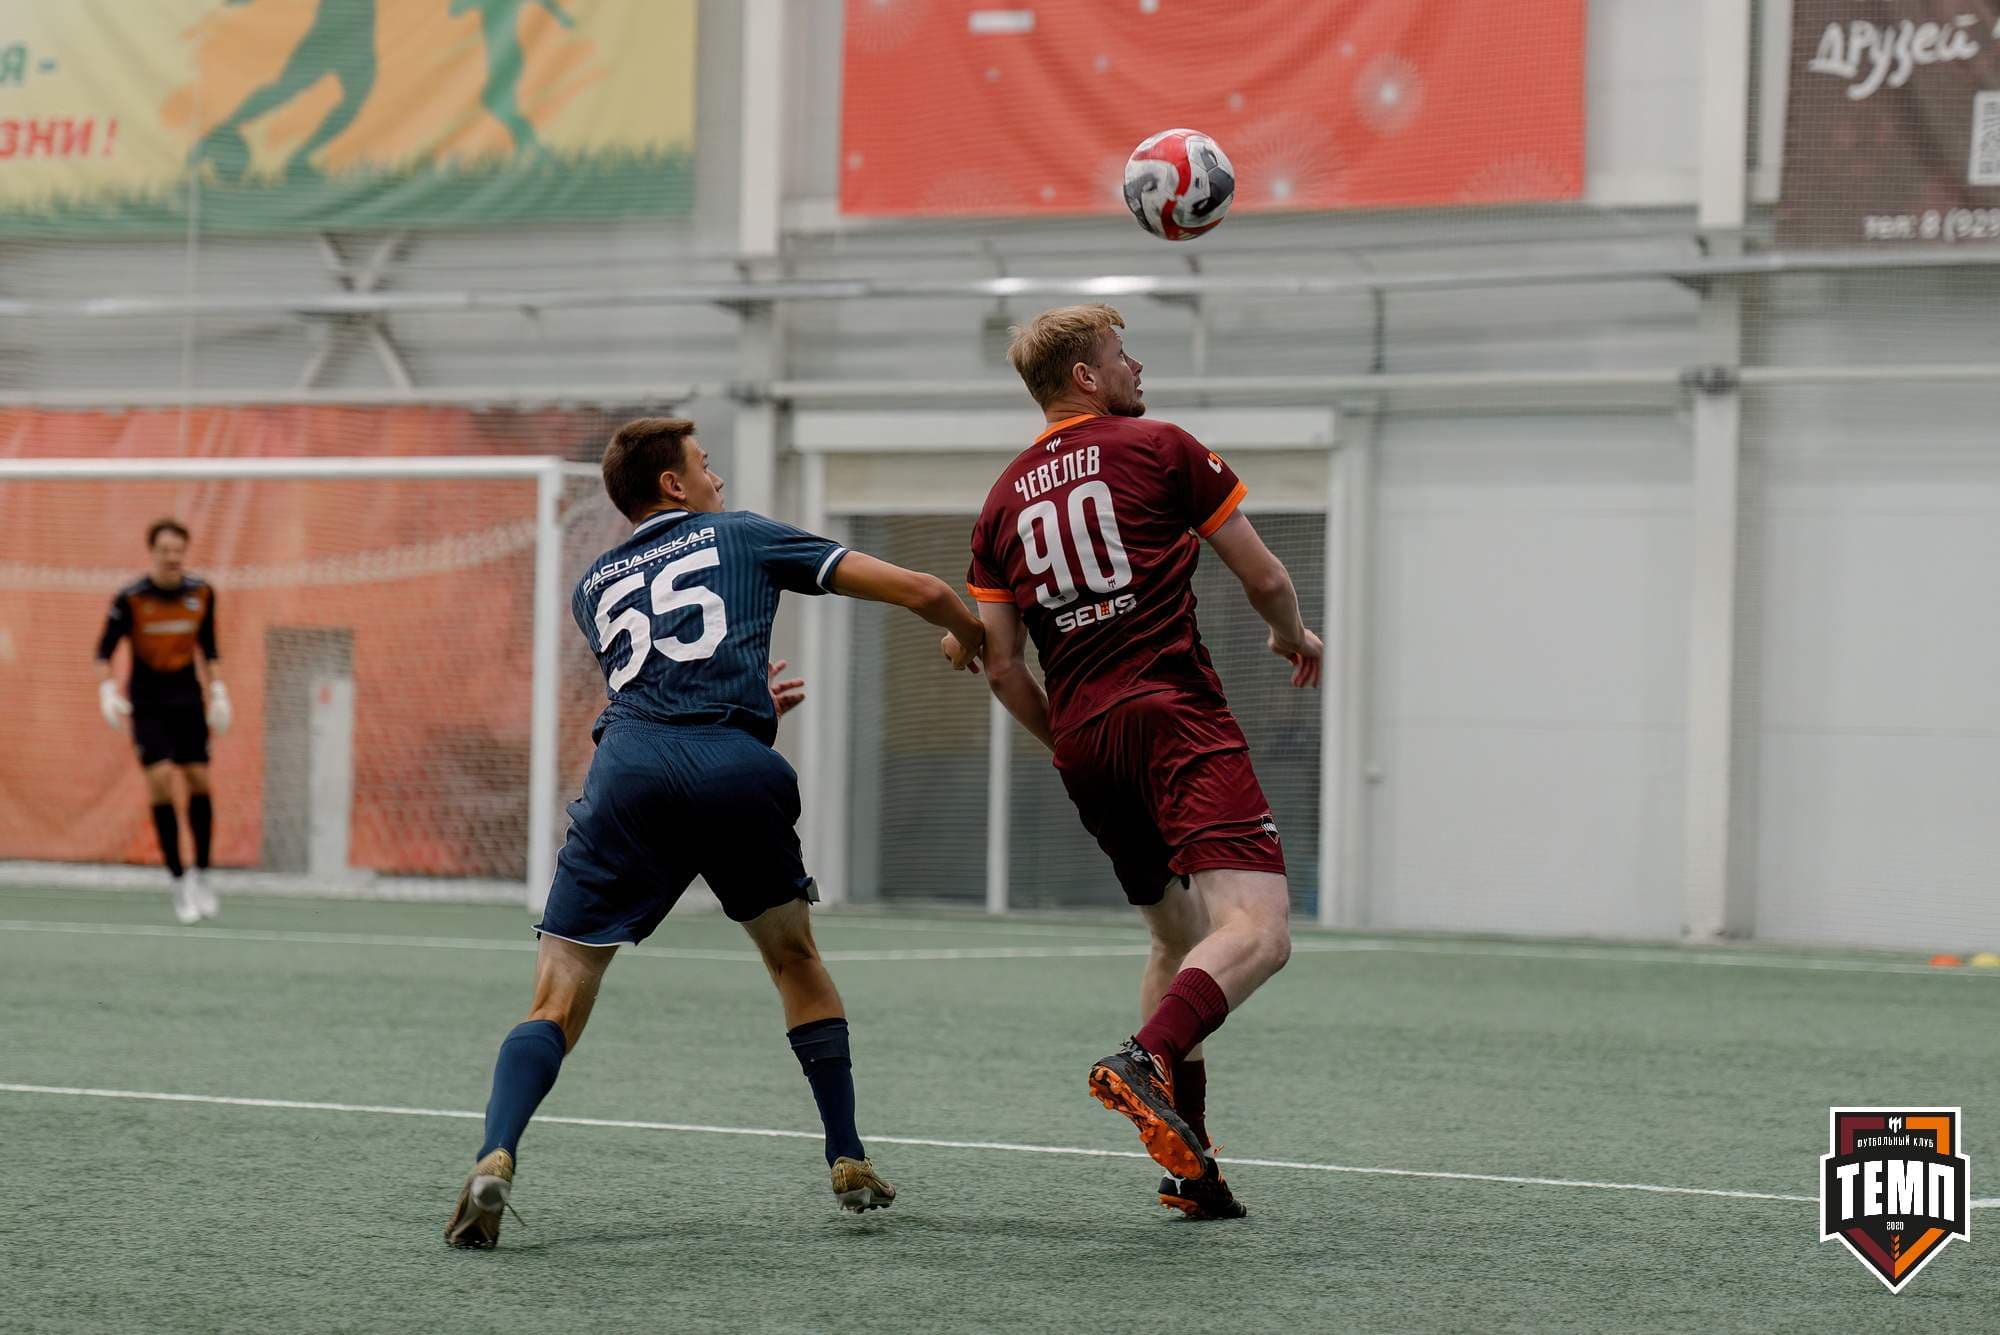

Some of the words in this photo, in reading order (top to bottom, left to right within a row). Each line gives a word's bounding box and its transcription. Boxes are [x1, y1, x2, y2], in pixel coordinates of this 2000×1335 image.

[1014, 445, 1100, 502] ЧЕВЕЛЕВ
[1017, 480, 1133, 609] 90
[595, 547, 727, 692] 55
